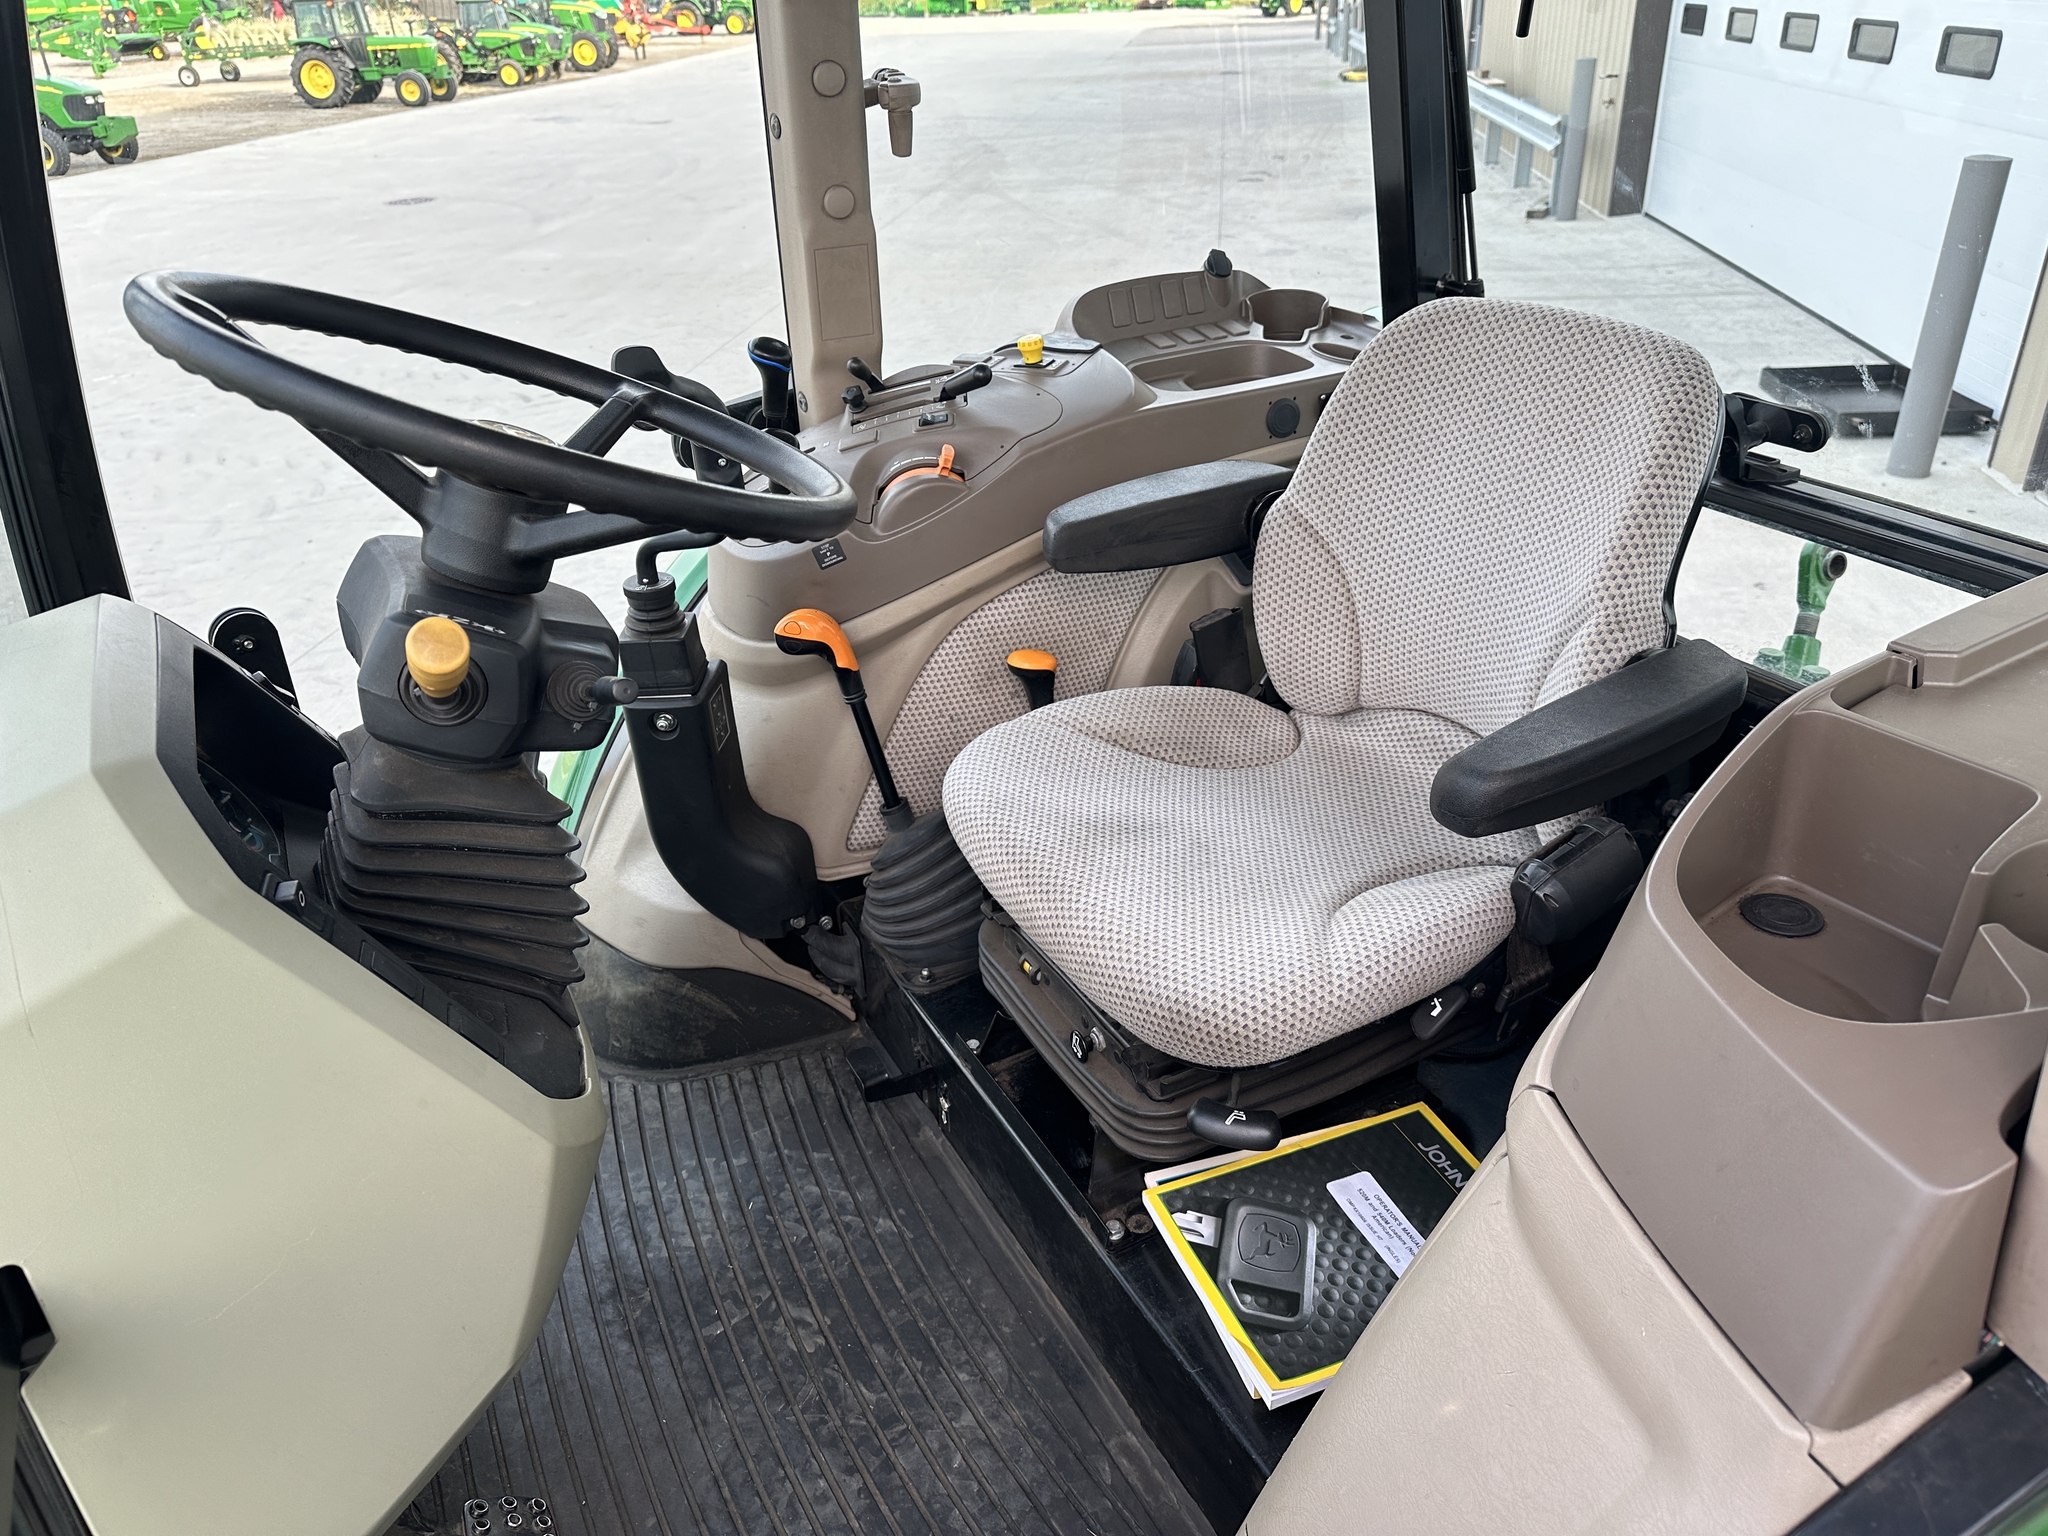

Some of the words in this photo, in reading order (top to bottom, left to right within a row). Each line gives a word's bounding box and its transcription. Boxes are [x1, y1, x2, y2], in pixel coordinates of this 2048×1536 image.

[1417, 1142, 1468, 1188] JOHN
[1368, 1202, 1378, 1212] and
[1389, 1225, 1407, 1246] Loaders
[1371, 1215, 1395, 1240] American)
[1373, 1194, 1403, 1227] OPERATOR'S
[1401, 1227, 1422, 1249] MANUAL
